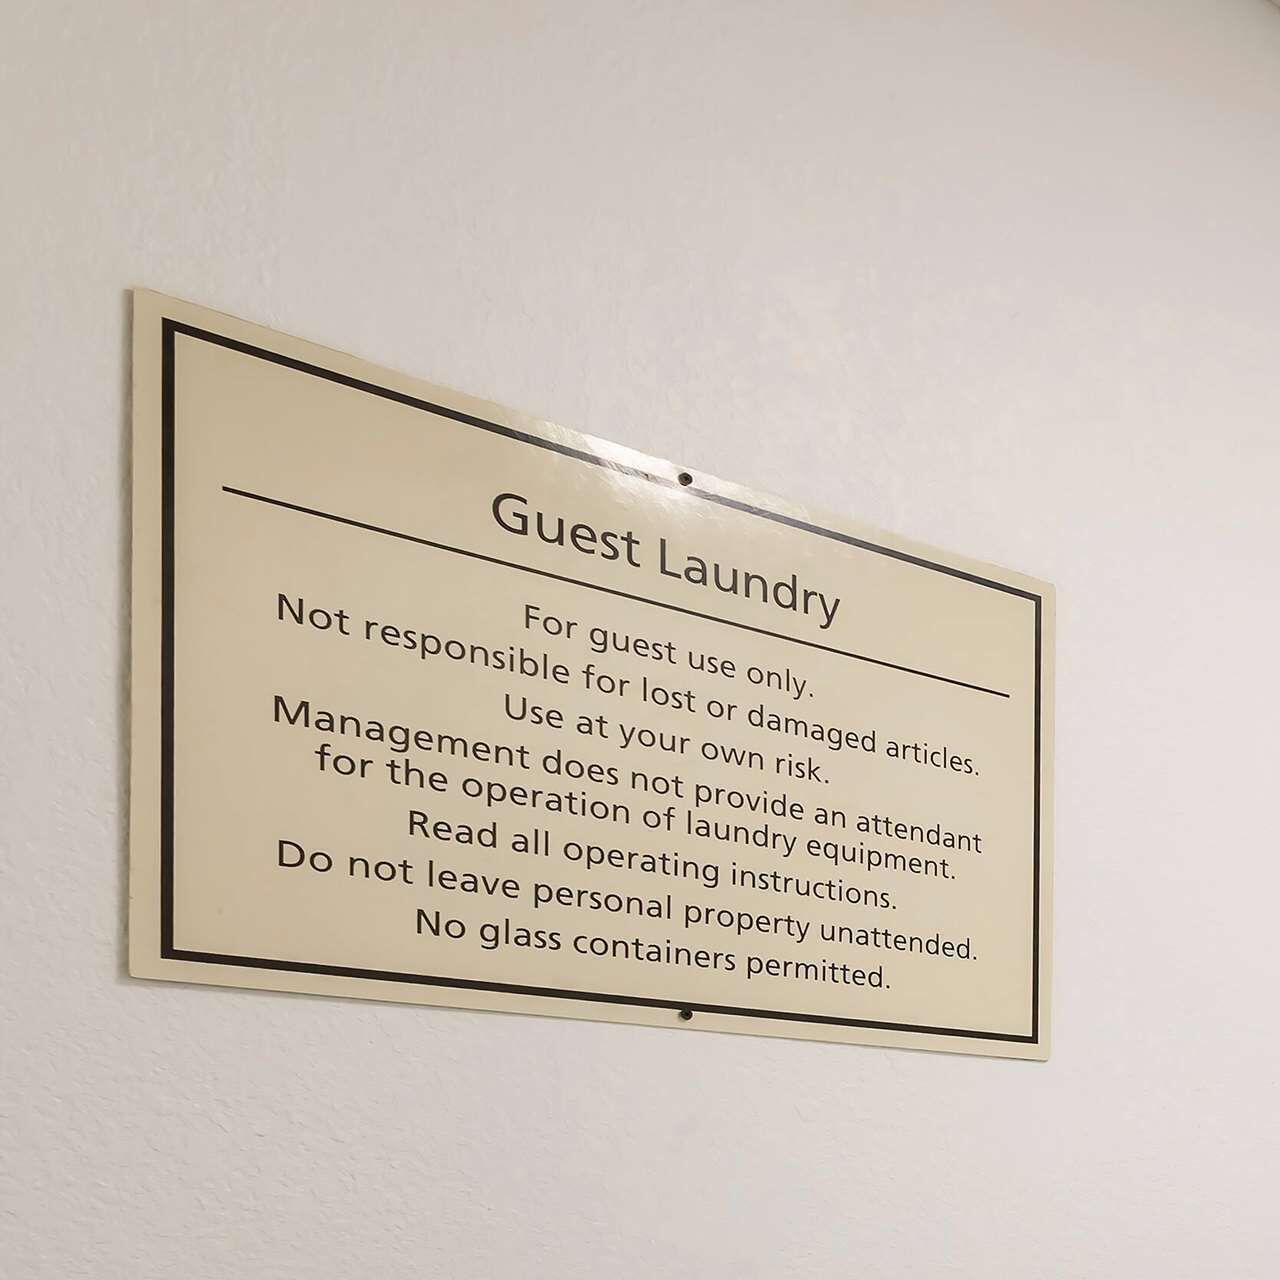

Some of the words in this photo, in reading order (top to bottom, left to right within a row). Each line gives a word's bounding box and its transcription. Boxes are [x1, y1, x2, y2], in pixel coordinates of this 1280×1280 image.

[492, 492, 641, 568] Guest
[660, 538, 840, 630] Laundry
[278, 593, 350, 636] Not
[365, 620, 570, 684] responsible
[582, 664, 630, 697] for
[643, 676, 696, 713] lost
[706, 700, 738, 721] or
[748, 704, 876, 753] damaged
[886, 741, 979, 776] articles.
[525, 604, 578, 639] For
[590, 627, 677, 665] guest
[688, 651, 736, 679] use
[747, 667, 814, 700] only.
[274, 695, 530, 770] Management
[542, 749, 619, 786] does
[631, 771, 684, 798] not
[695, 783, 804, 820] provide
[814, 807, 846, 829] an
[856, 814, 982, 854] attendant
[505, 693, 563, 729] Use
[576, 715, 609, 739] at
[619, 724, 691, 754] your
[701, 742, 764, 770] own
[776, 753, 829, 784] risk.
[315, 743, 374, 778] for
[385, 758, 448, 792] the
[462, 778, 630, 824] operation
[642, 806, 676, 831] of
[687, 809, 797, 858] laundry
[806, 839, 955, 880] equipment.
[409, 810, 497, 849] Read
[511, 828, 549, 857] all
[563, 842, 719, 889] operating
[732, 861, 896, 910] instructions.
[278, 839, 333, 873] Do
[349, 856, 413, 885] not
[428, 860, 520, 899] leave
[534, 883, 671, 920] personal
[685, 905, 810, 944] property
[821, 924, 977, 960] unattended.
[416, 908, 466, 939] No
[479, 918, 561, 951] glass
[573, 935, 736, 971] containers
[747, 956, 890, 989] permitted.
